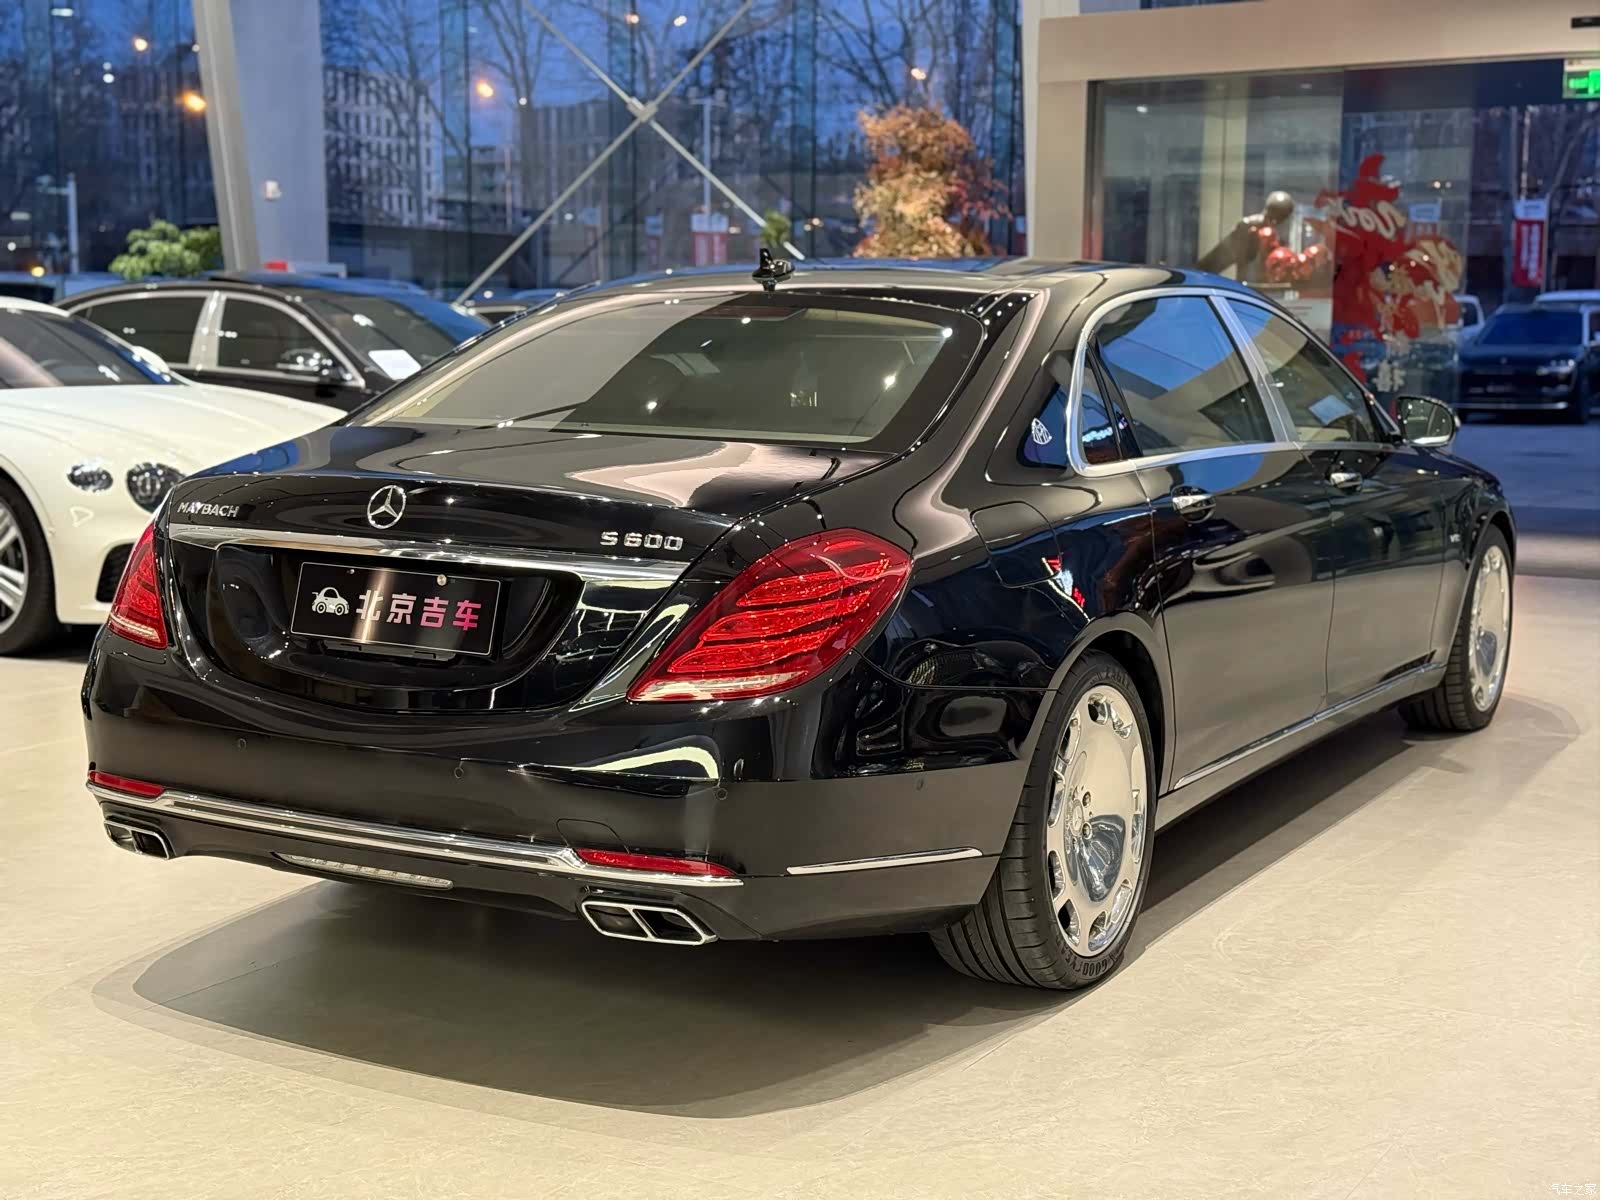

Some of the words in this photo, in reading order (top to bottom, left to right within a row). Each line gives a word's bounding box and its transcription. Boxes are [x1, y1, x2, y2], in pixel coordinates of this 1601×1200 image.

[177, 502, 240, 517] MAYBACH
[600, 531, 619, 546] S
[624, 532, 684, 551] 600
[356, 590, 481, 631] 北京吉车
